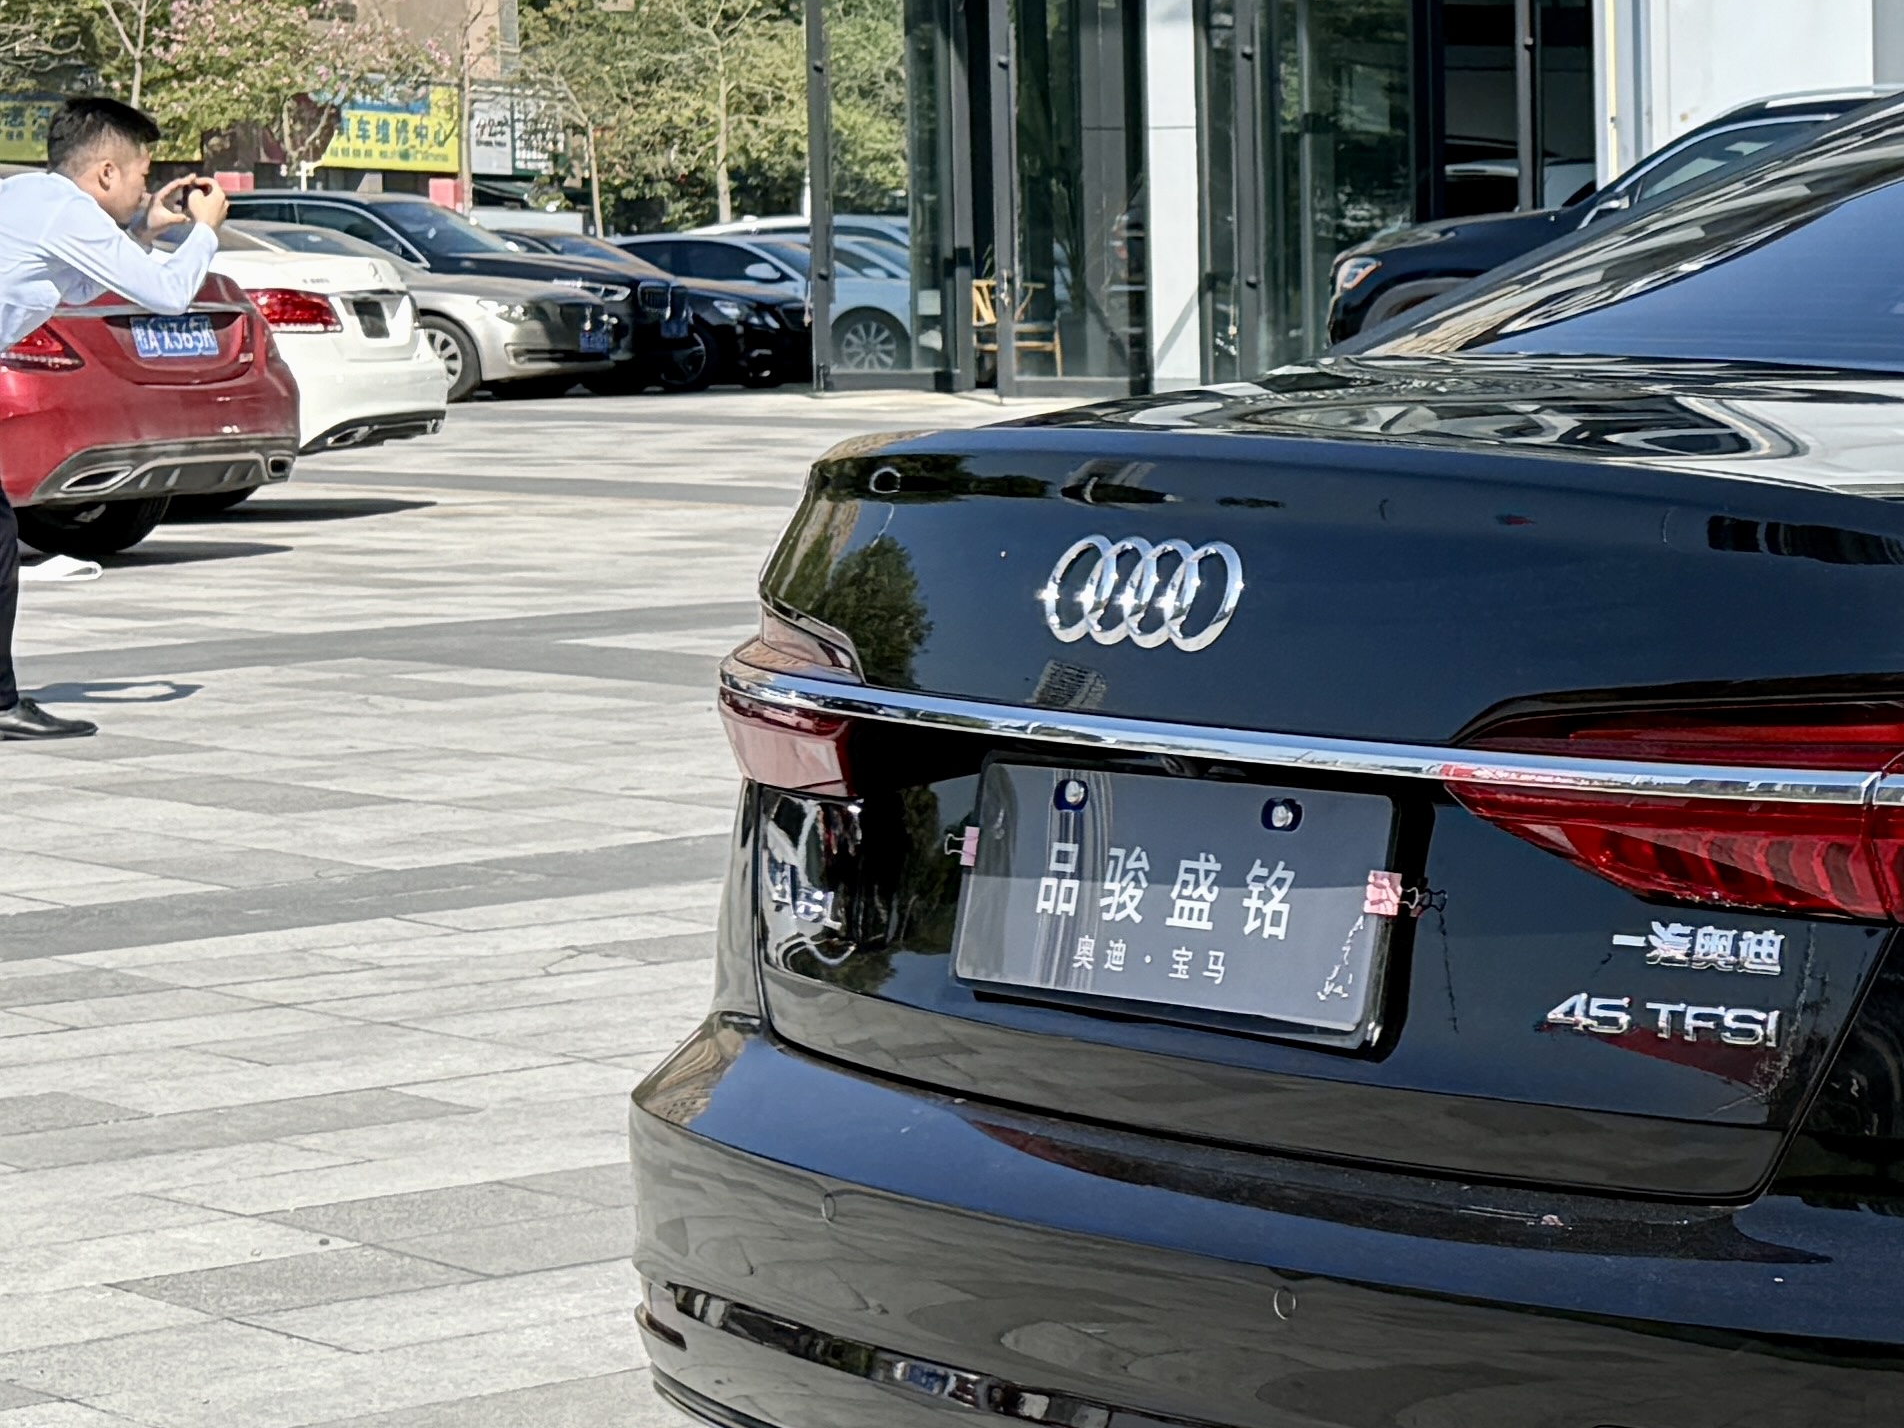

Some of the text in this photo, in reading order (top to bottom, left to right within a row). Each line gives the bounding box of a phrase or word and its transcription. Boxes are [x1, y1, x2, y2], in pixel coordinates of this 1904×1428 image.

[1035, 841, 1297, 941] 品骏盛铭
[1612, 921, 1786, 976] 一汽奥迪
[1547, 992, 1782, 1048] 45 TFSI
